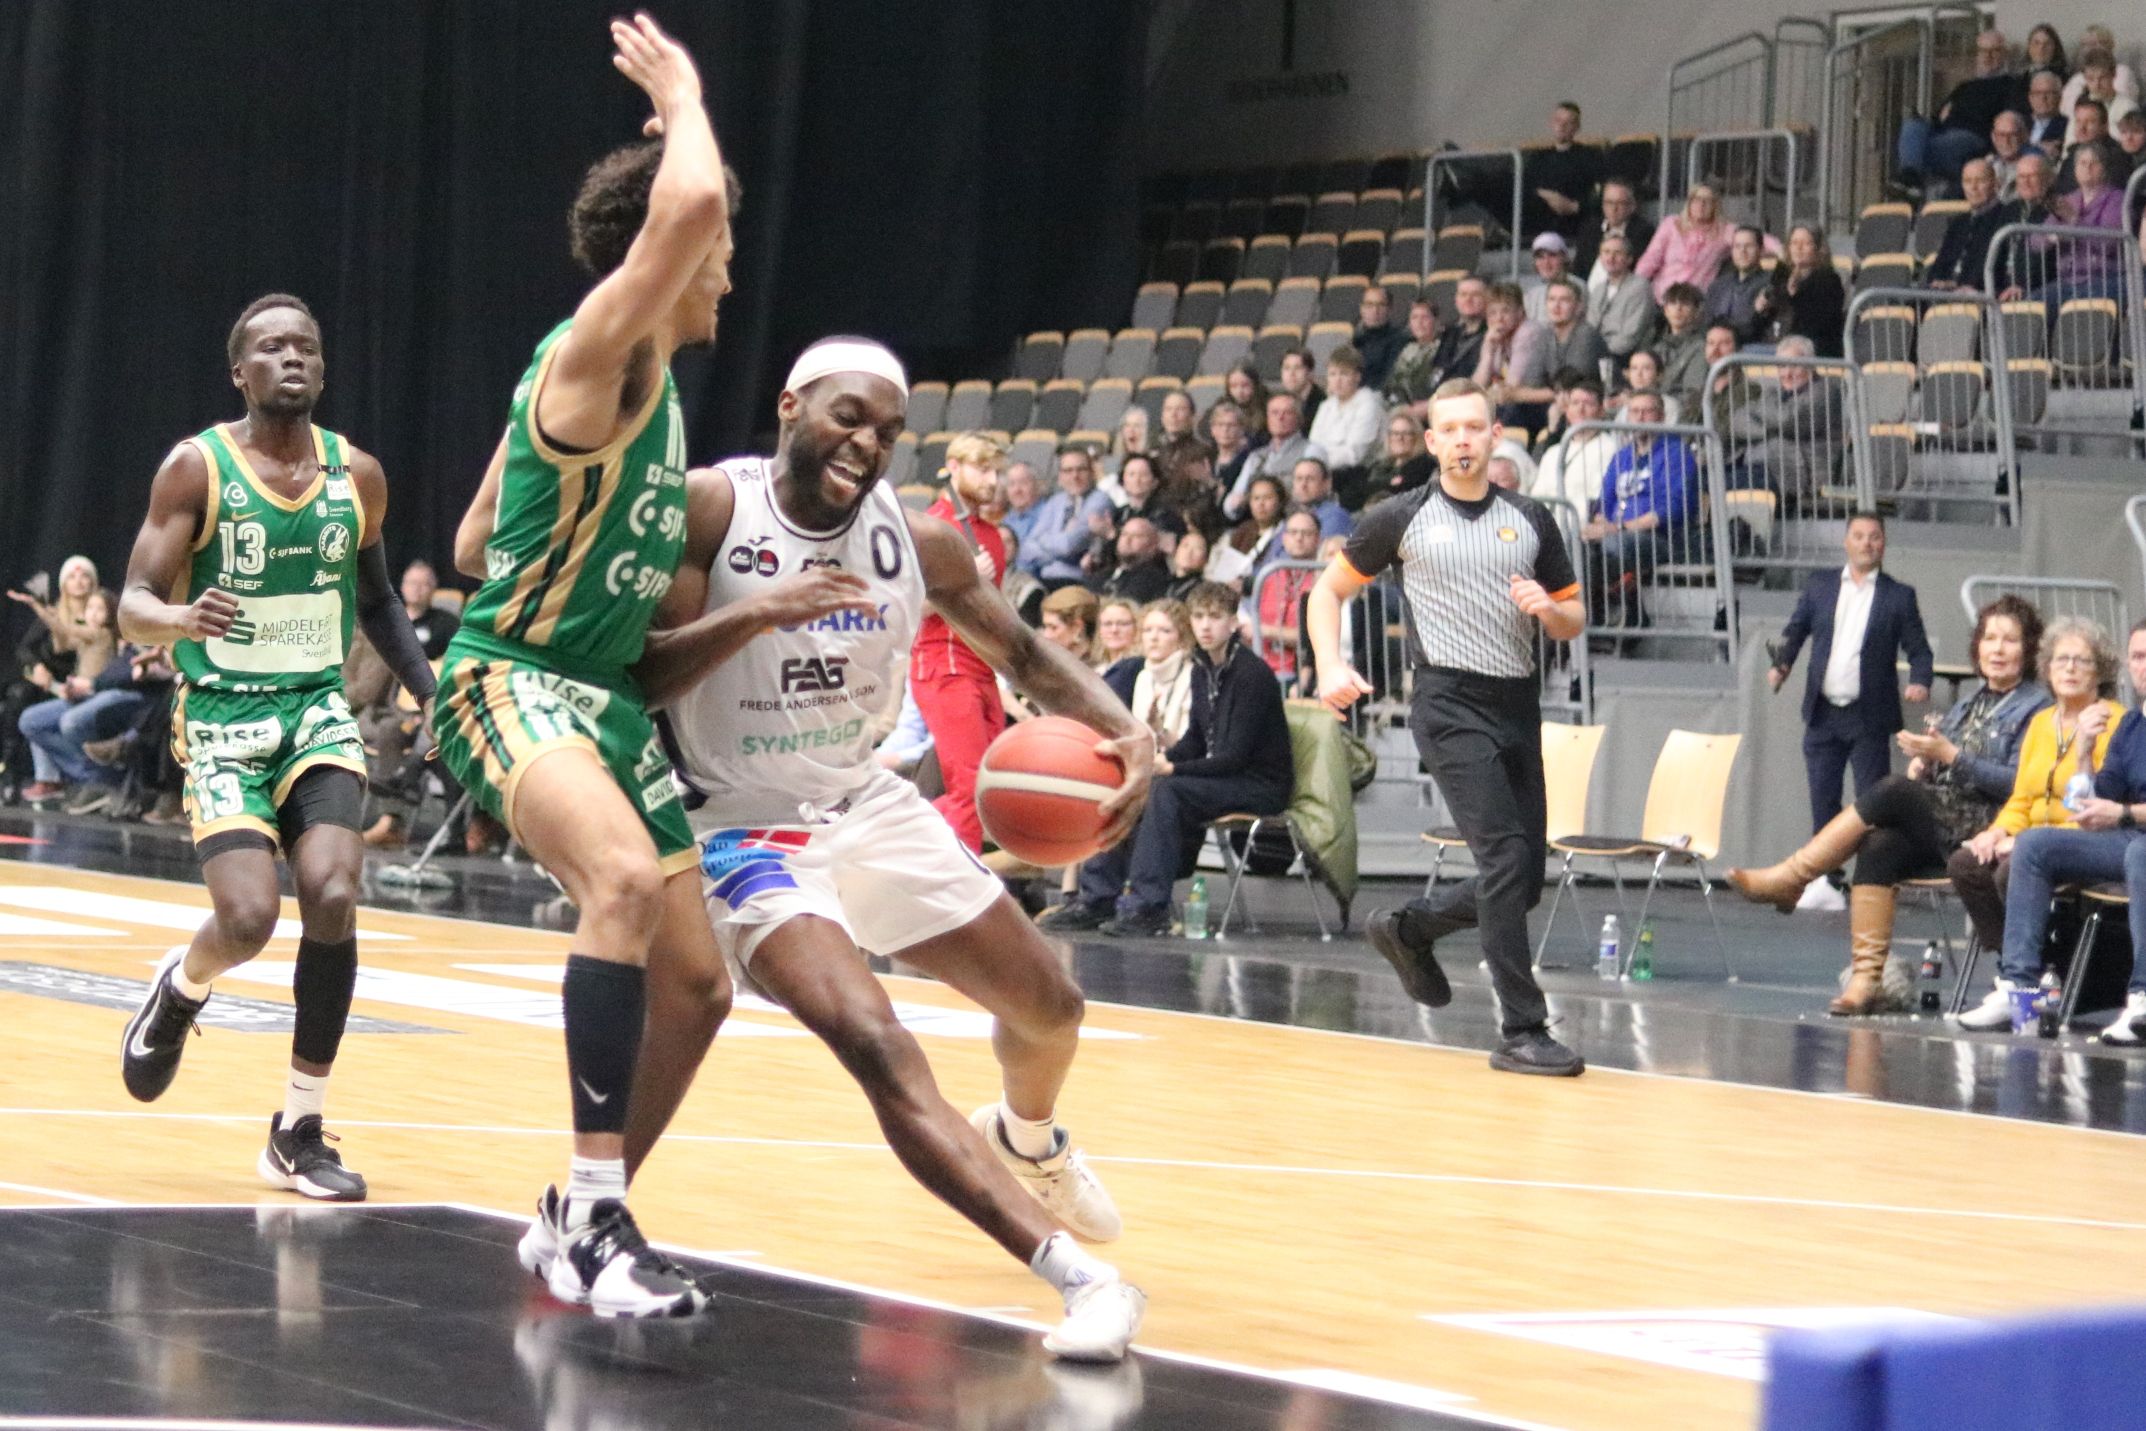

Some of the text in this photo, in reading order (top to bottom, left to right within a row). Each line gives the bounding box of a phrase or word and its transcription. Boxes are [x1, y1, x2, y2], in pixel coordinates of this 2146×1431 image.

[219, 521, 266, 575] 13
[870, 525, 902, 582] 0
[233, 579, 264, 590] SEF
[777, 604, 889, 633] ARK
[739, 700, 781, 711] FREDE
[785, 694, 848, 710] ANDERSEN
[195, 728, 270, 745] Rise
